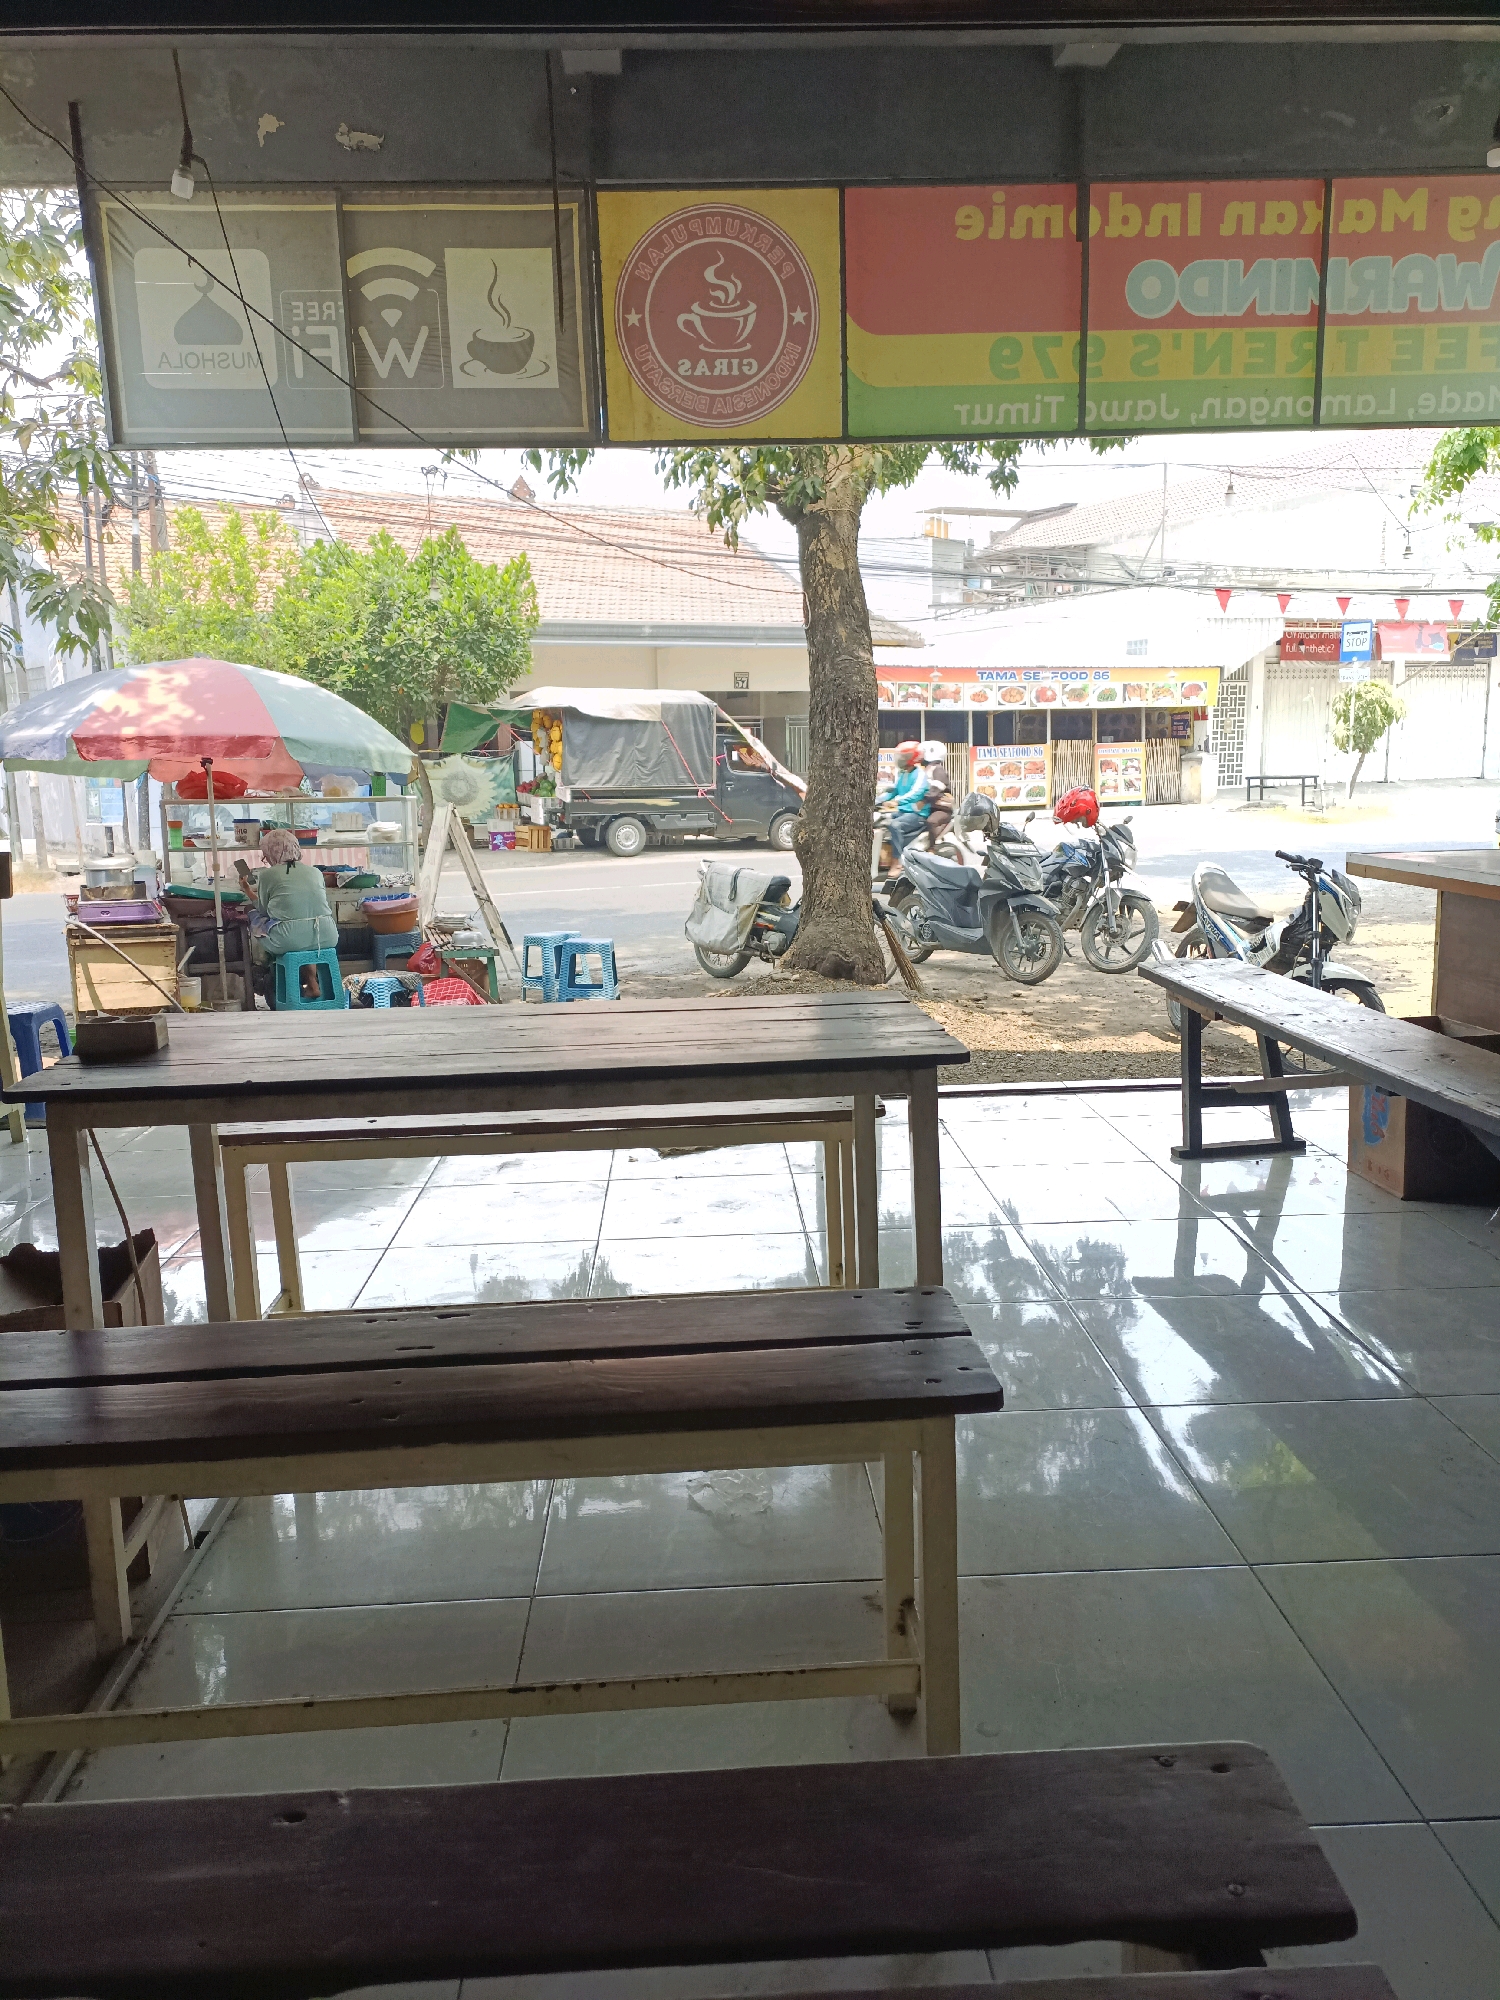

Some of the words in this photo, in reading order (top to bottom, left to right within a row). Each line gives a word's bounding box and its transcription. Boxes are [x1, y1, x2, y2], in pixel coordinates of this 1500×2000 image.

[1346, 638, 1368, 648] STOP
[977, 671, 1017, 681] TAMA
[1022, 671, 1089, 681] SEFOOD
[1093, 671, 1110, 680] 86
[978, 747, 999, 758] TAMA
[999, 747, 1031, 758] SEAFOOD
[1034, 746, 1043, 757] 86
